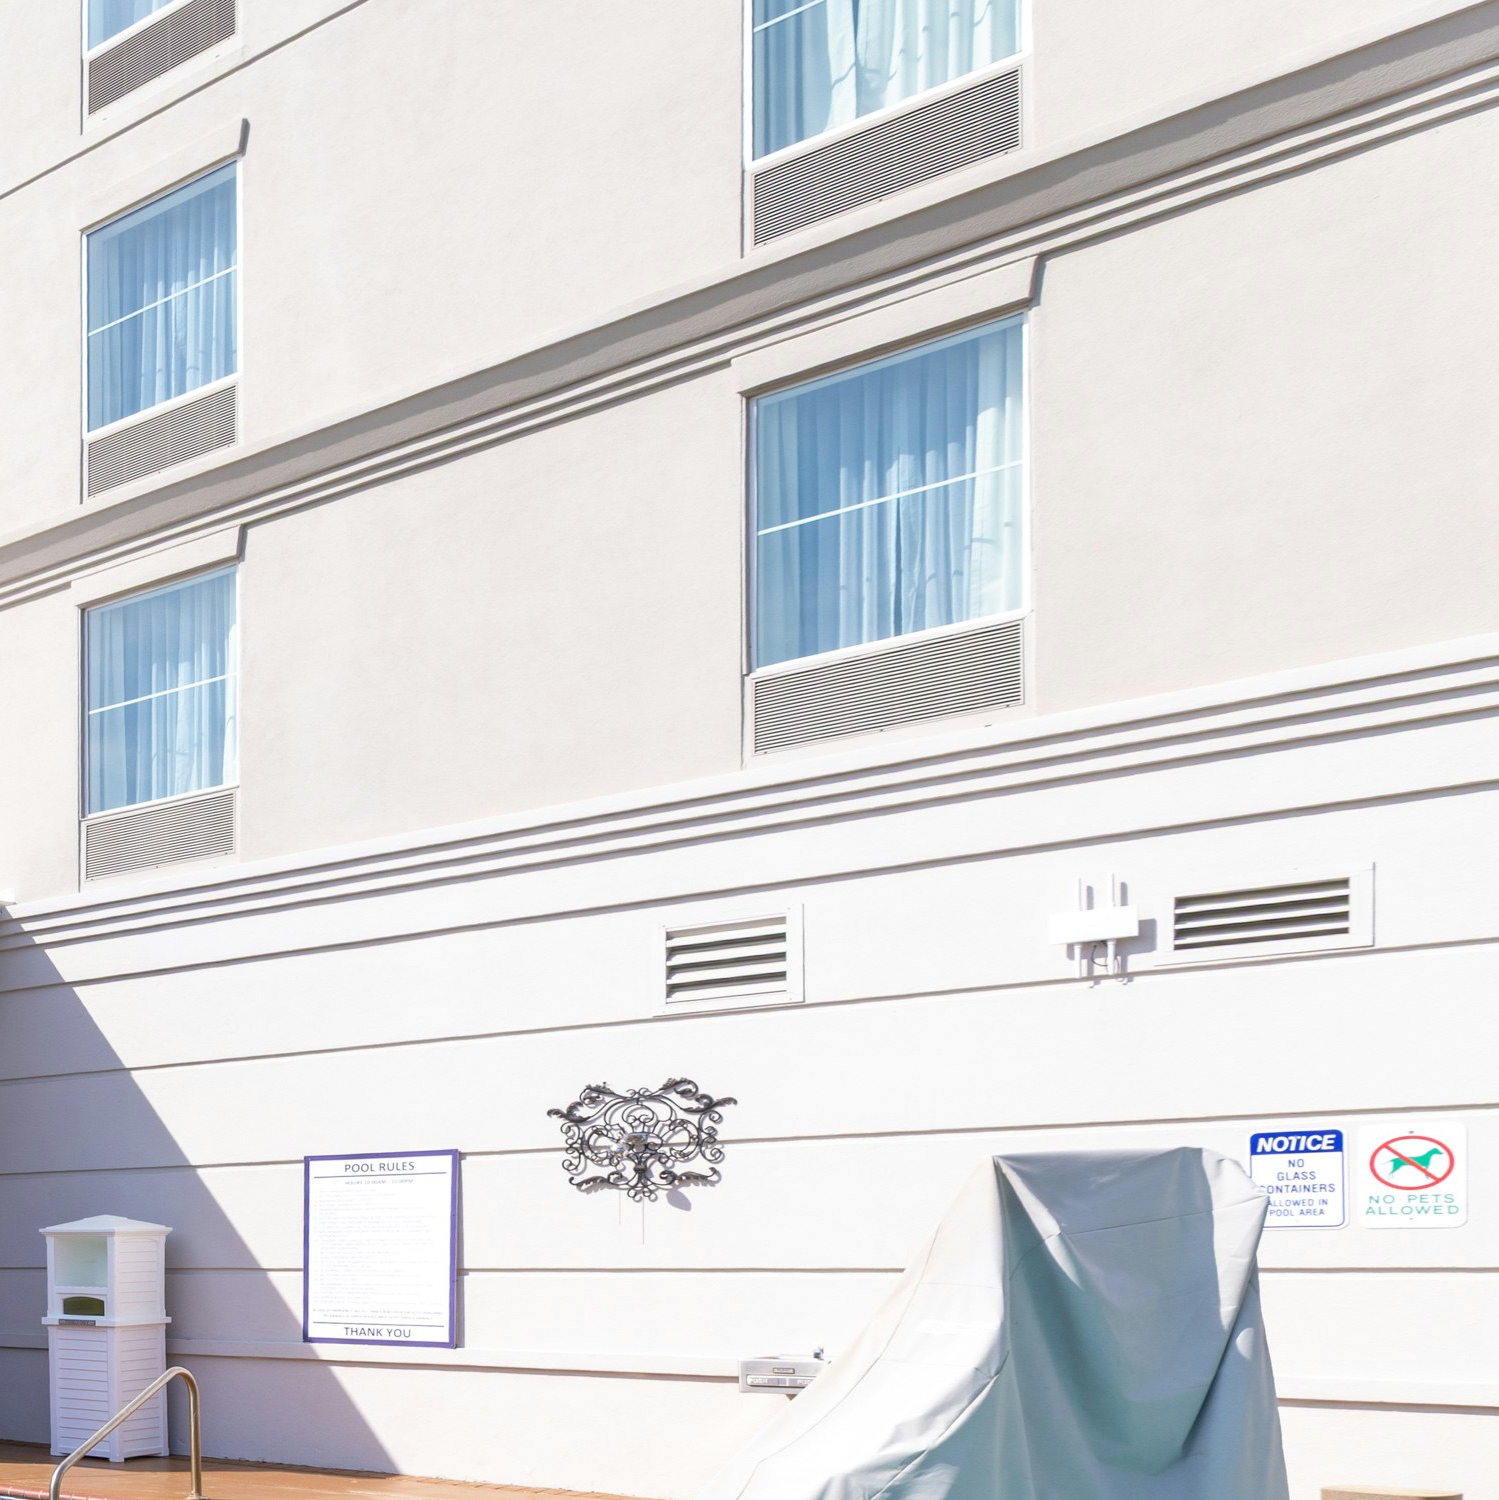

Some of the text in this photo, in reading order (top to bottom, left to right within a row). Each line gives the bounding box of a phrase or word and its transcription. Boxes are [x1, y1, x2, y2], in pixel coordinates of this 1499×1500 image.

[1256, 1133, 1336, 1153] NOTICE
[344, 1161, 415, 1173] POOL RULES
[1288, 1158, 1305, 1168] NO
[1276, 1171, 1317, 1182] GLASS
[1318, 1198, 1328, 1206] IN
[1368, 1193, 1456, 1204] NO PETS
[1269, 1208, 1325, 1217] POOL AREA
[1365, 1205, 1460, 1216] ALLOWED
[344, 1326, 411, 1338] THANK YOU
